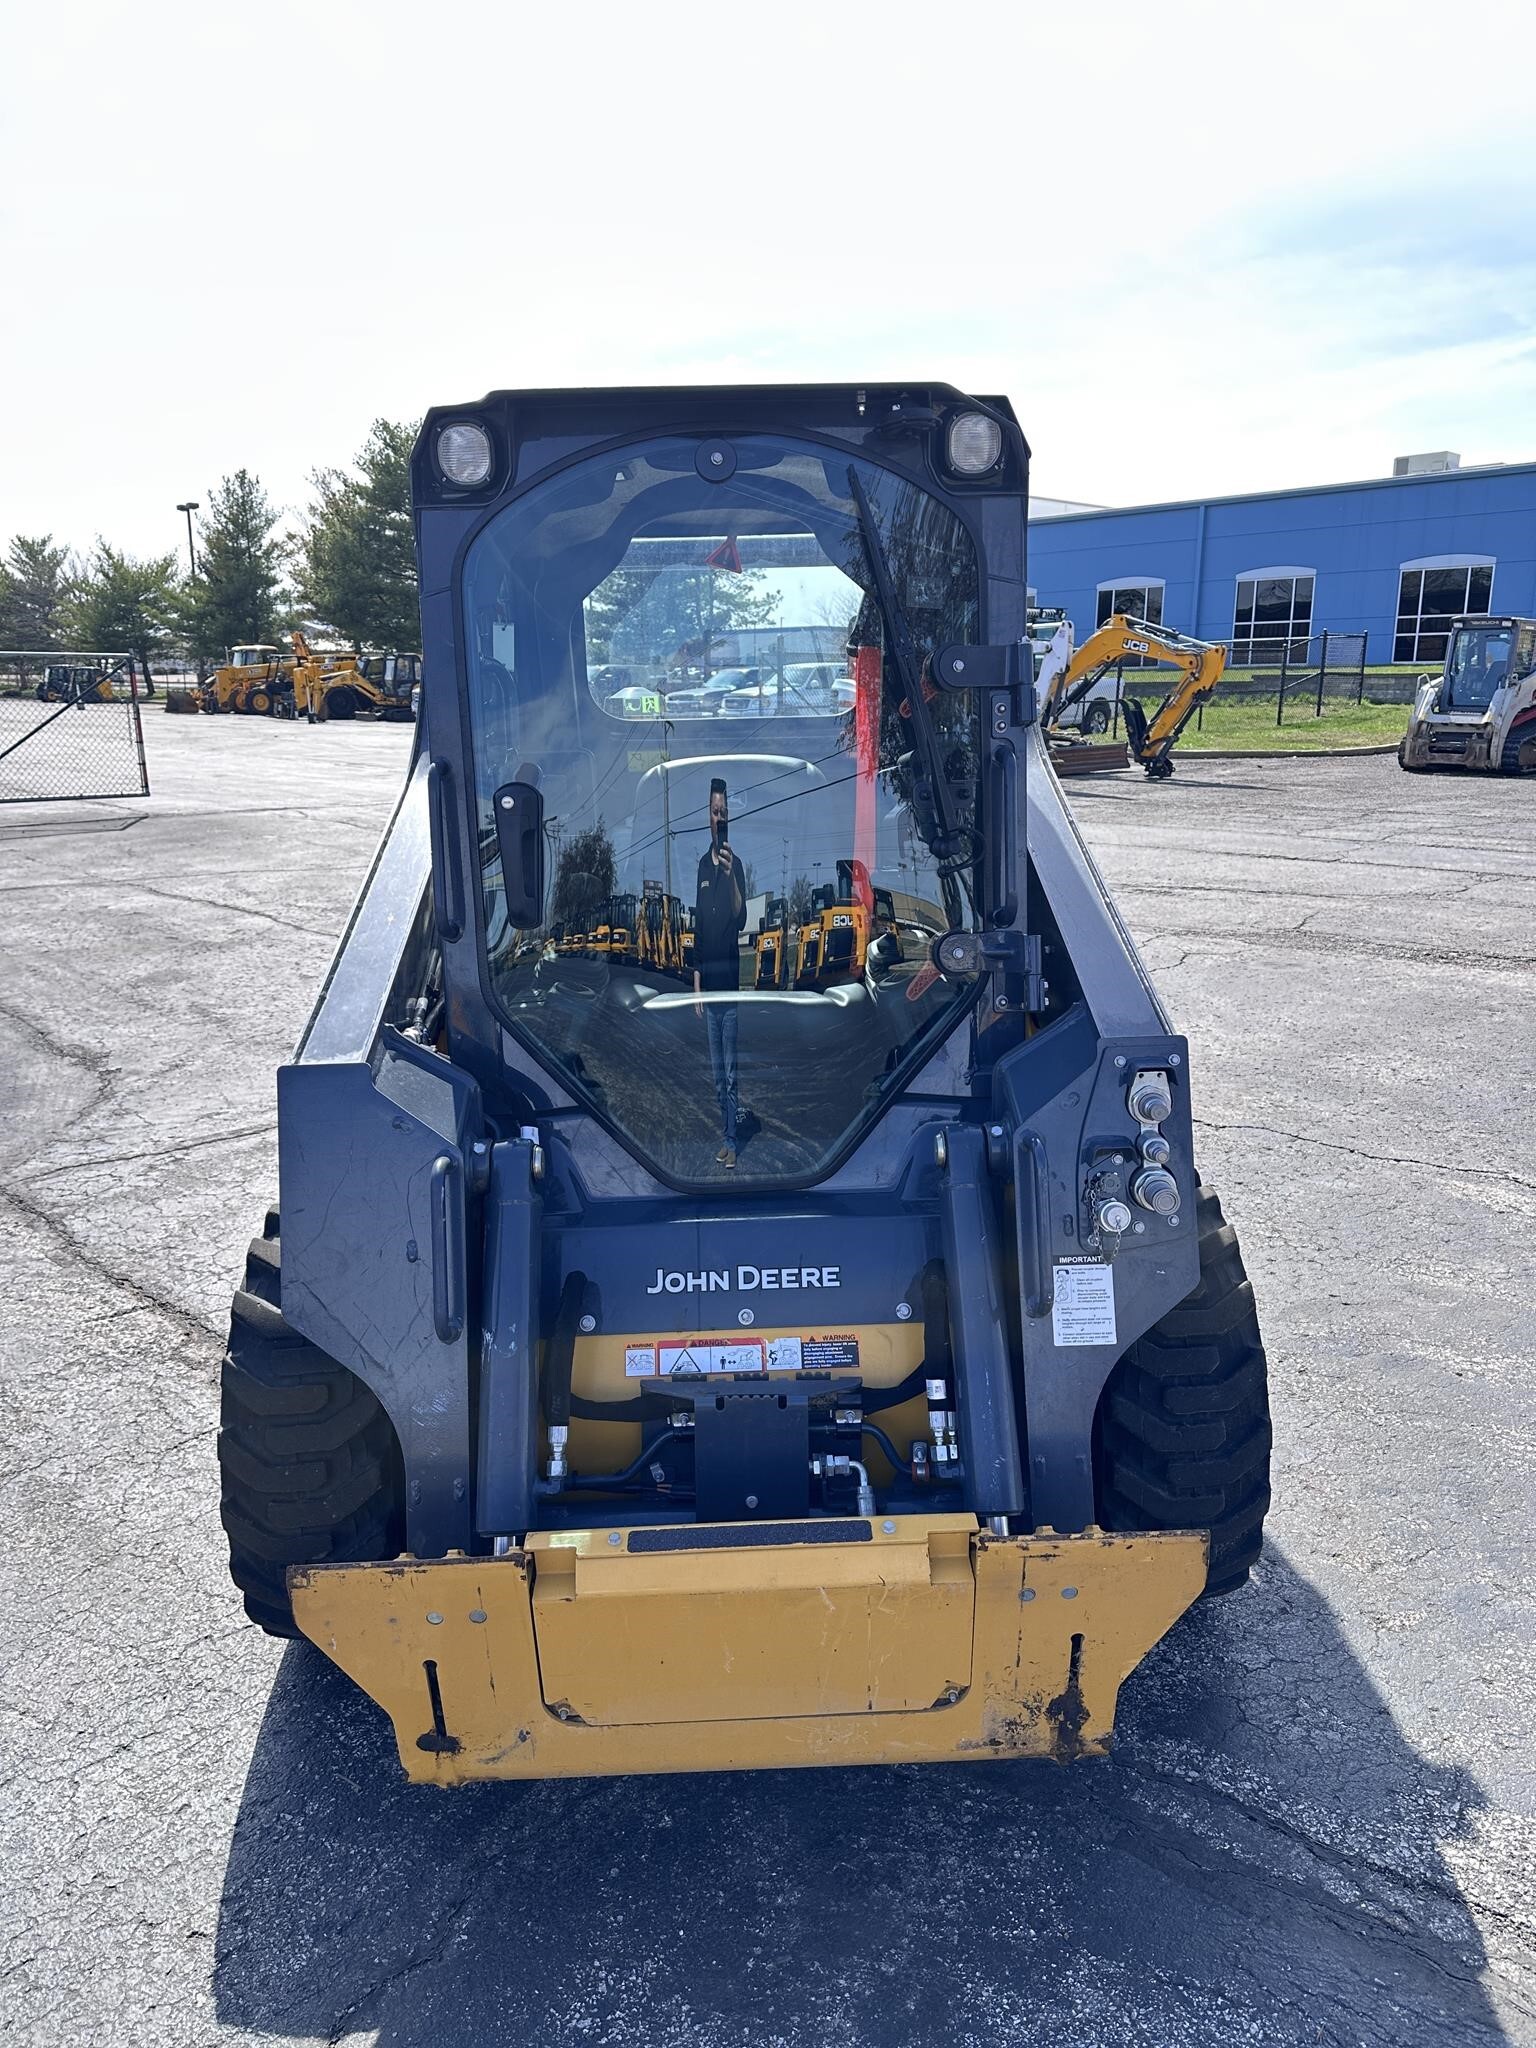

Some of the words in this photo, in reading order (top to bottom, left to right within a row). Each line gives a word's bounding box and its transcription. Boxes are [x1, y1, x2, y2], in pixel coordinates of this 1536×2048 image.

[1122, 638, 1149, 652] JCB
[647, 1268, 730, 1294] JOHN
[737, 1265, 841, 1291] DEERE
